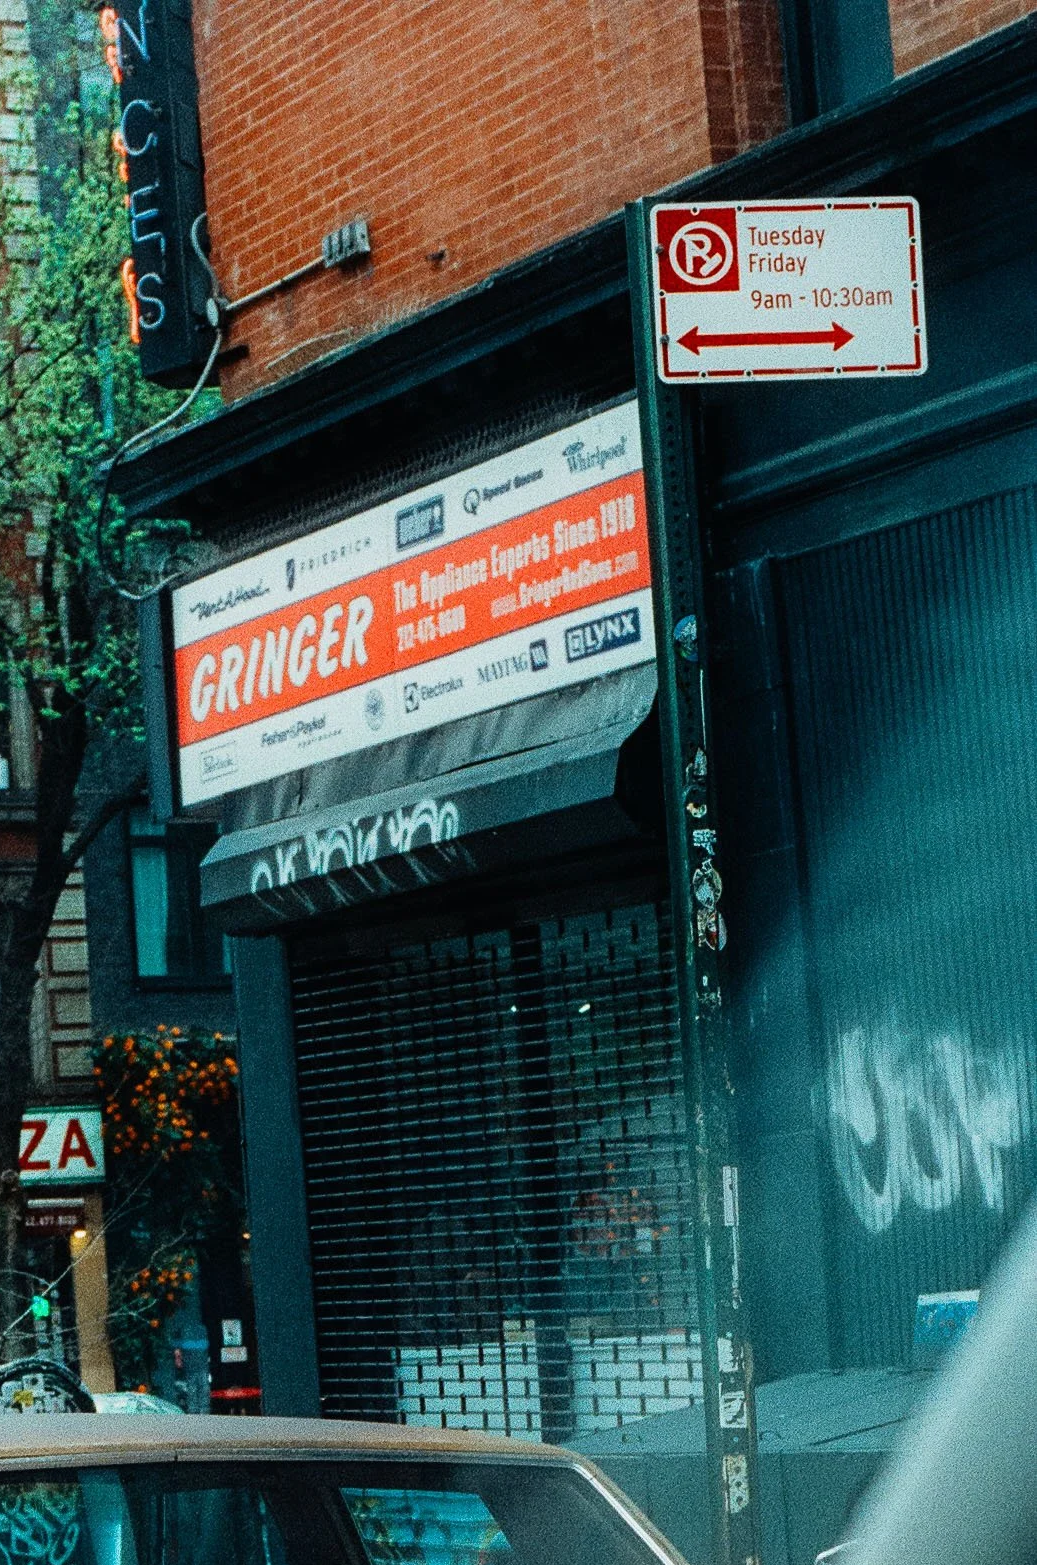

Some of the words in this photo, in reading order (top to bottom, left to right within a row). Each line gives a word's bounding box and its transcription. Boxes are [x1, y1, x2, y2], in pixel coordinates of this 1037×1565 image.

[748, 225, 826, 248] Tuesday
[749, 253, 808, 276] Friday
[750, 289, 792, 309] 9am
[812, 287, 893, 308] 10:30am
[393, 580, 418, 615] The
[420, 557, 488, 611] Appliance
[490, 532, 551, 582] Experts
[553, 516, 597, 555] Since
[584, 611, 638, 651] LYNX
[189, 594, 375, 723] GRINGER
[477, 652, 529, 686] MAYTAG
[420, 677, 465, 701] Electrolux
